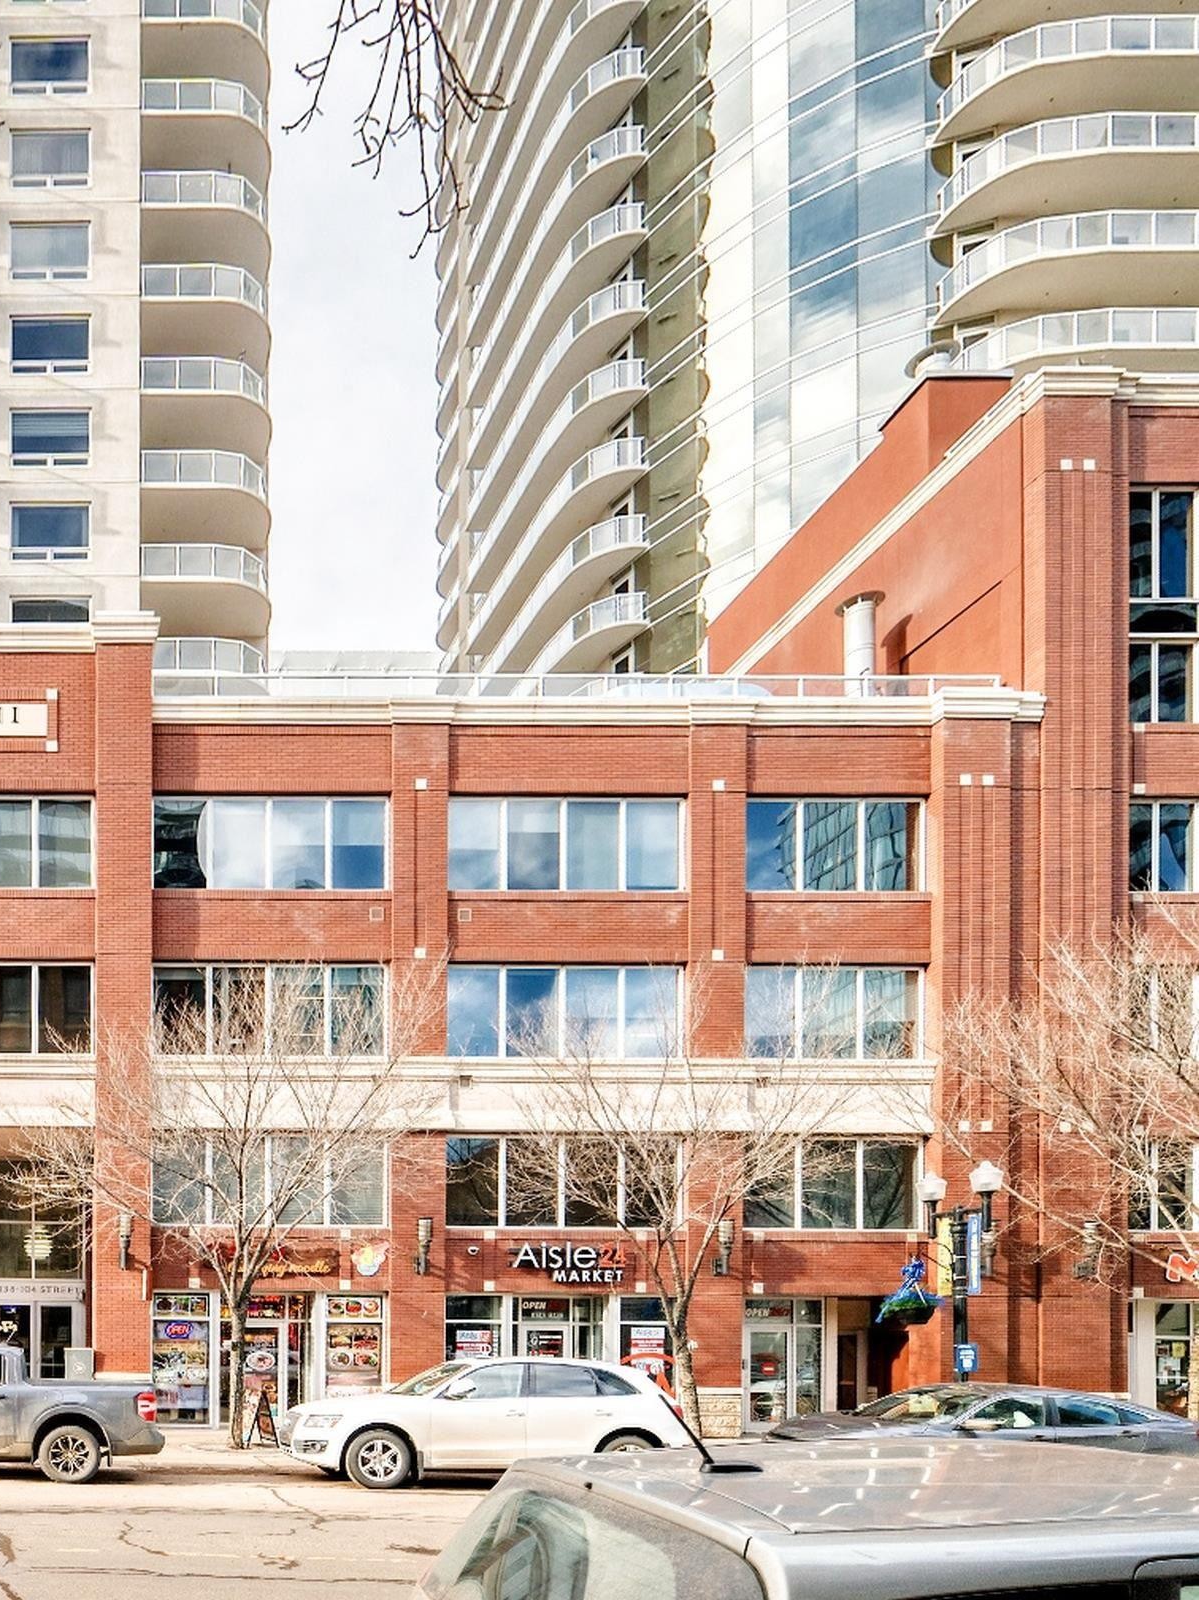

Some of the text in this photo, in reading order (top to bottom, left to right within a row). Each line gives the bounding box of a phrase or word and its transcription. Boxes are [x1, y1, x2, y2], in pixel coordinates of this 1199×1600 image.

[12, 706, 20, 724] I
[552, 1270, 624, 1283] MARKET
[522, 1301, 547, 1310] OPEN
[745, 1307, 770, 1317] OPEN
[167, 1323, 190, 1335] OPEN
